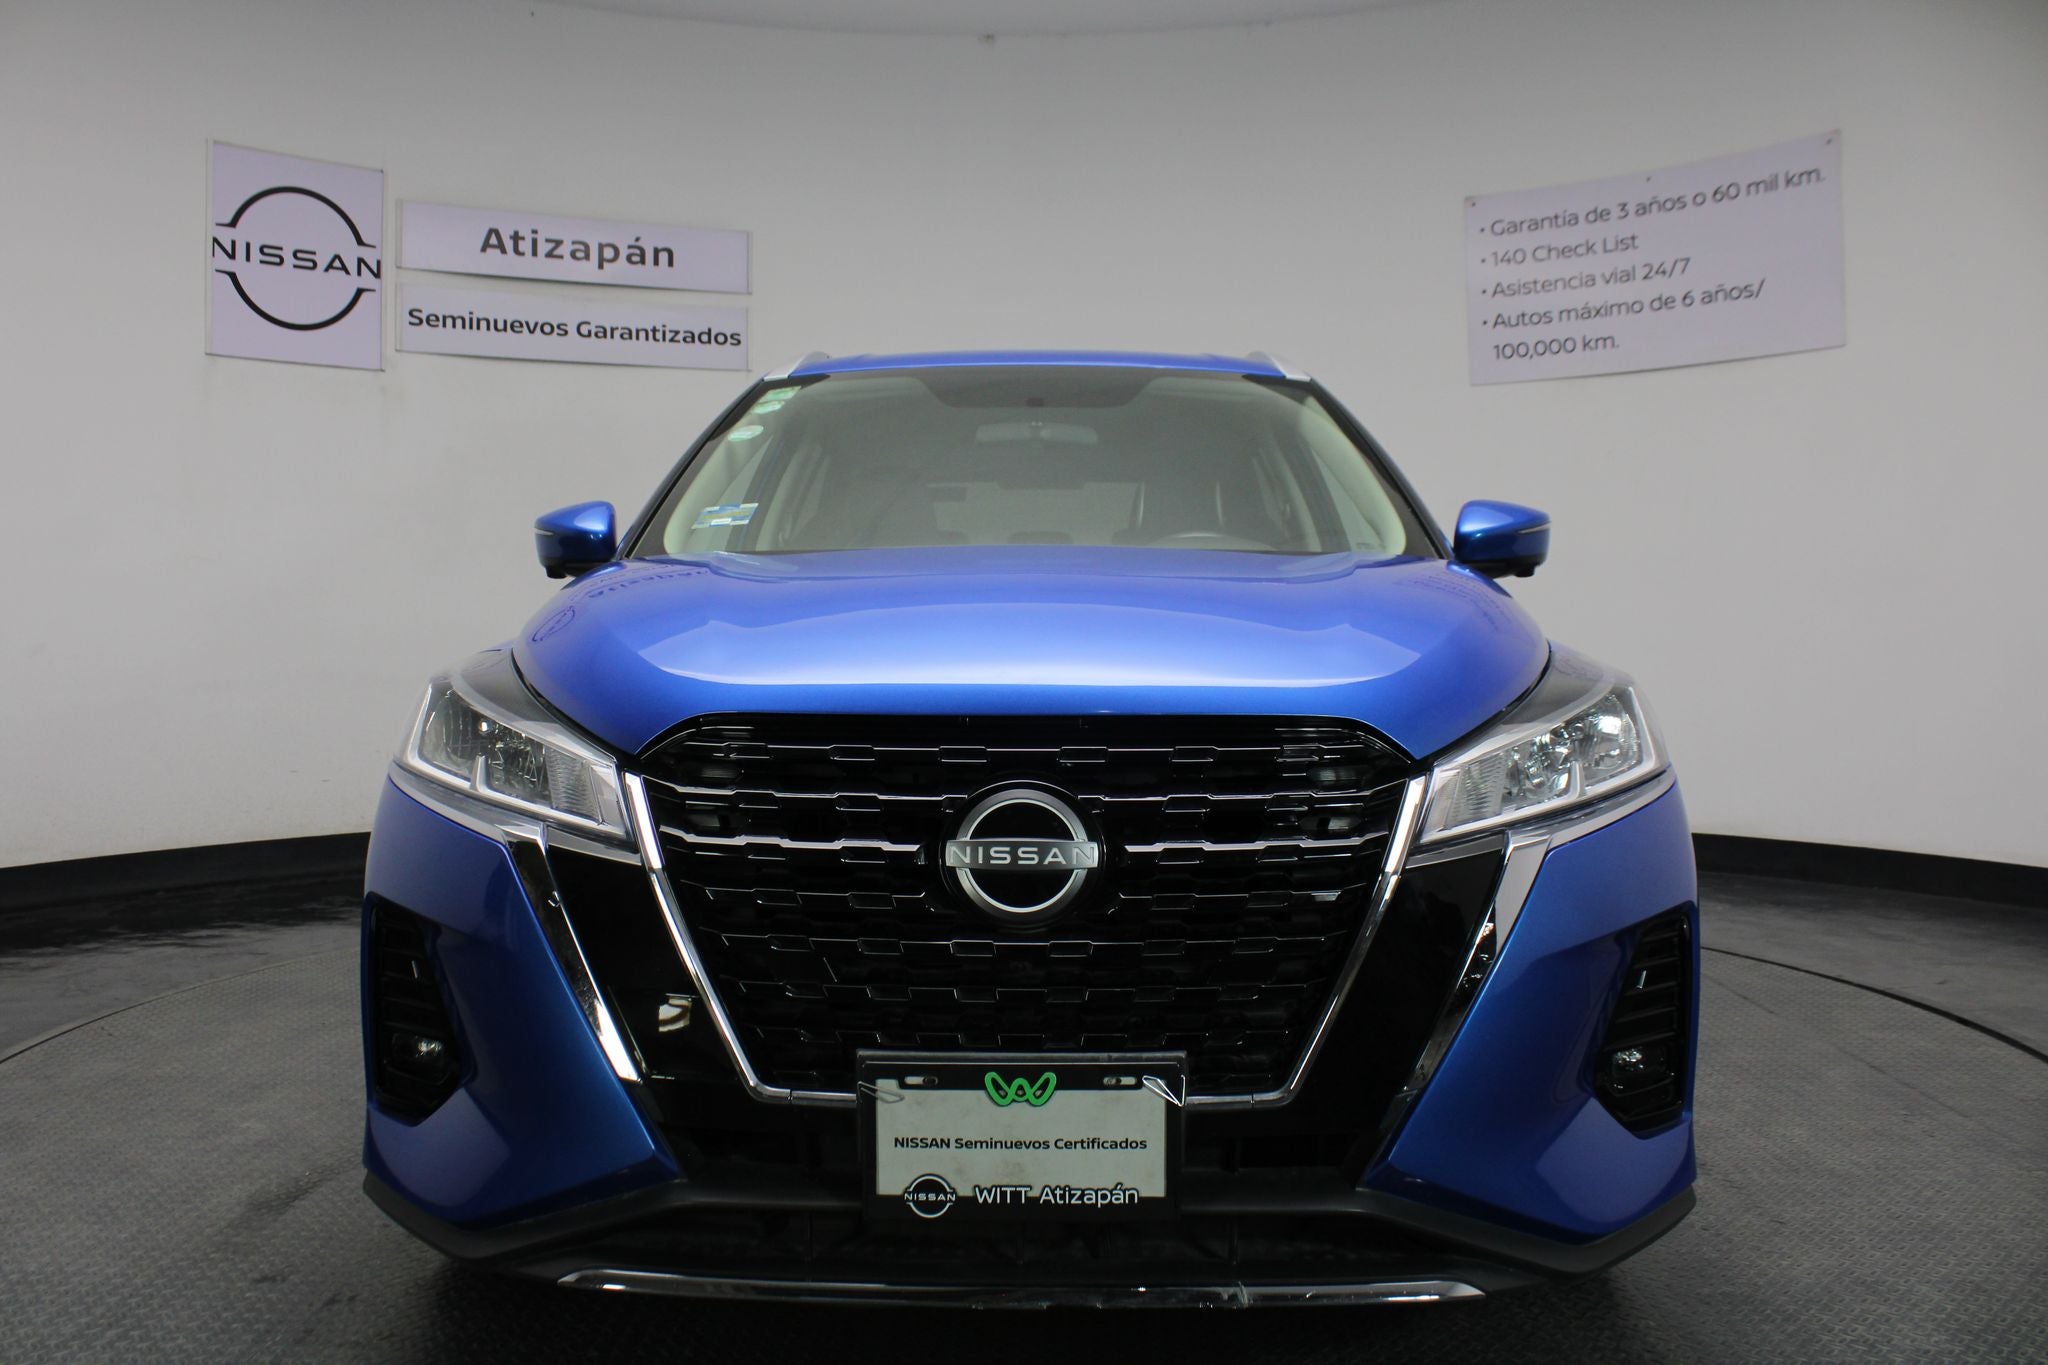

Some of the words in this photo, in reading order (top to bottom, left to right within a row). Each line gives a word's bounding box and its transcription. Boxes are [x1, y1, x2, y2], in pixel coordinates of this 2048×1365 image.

[1490, 209, 1580, 237] Garantía
[1584, 204, 1612, 225] de
[1616, 203, 1630, 220] 3
[1634, 194, 1688, 217] años
[1691, 191, 1707, 206] o
[1711, 181, 1742, 202] 60
[1744, 174, 1781, 197] mil
[1784, 165, 1826, 187] km.
[212, 235, 382, 280] NISSAN
[479, 225, 676, 270] Atizapán
[1490, 247, 1527, 268] 140
[1531, 242, 1598, 263] Check
[1602, 233, 1640, 254] List
[1491, 273, 1597, 300] Asistencia
[1600, 264, 1637, 285] vial
[1641, 257, 1691, 283] 24/7
[1492, 310, 1554, 330] Autos
[1558, 299, 1645, 323] máximo
[1649, 292, 1677, 312] de
[1681, 290, 1696, 307] 6
[1700, 278, 1766, 304] años/
[407, 307, 569, 338] Seminuevos
[575, 320, 742, 347] Garantizados
[1493, 337, 1577, 361] 100,000
[1581, 331, 1621, 353] km.
[950, 846, 1096, 865] NISSAN
[893, 1137, 951, 1149] NISSAN
[954, 1138, 1051, 1150] Seminuevos
[1054, 1137, 1148, 1150] Certificados
[904, 1192, 956, 1202] NISSAN
[974, 1186, 1031, 1204] WITT
[1039, 1182, 1139, 1208] Atizapán
